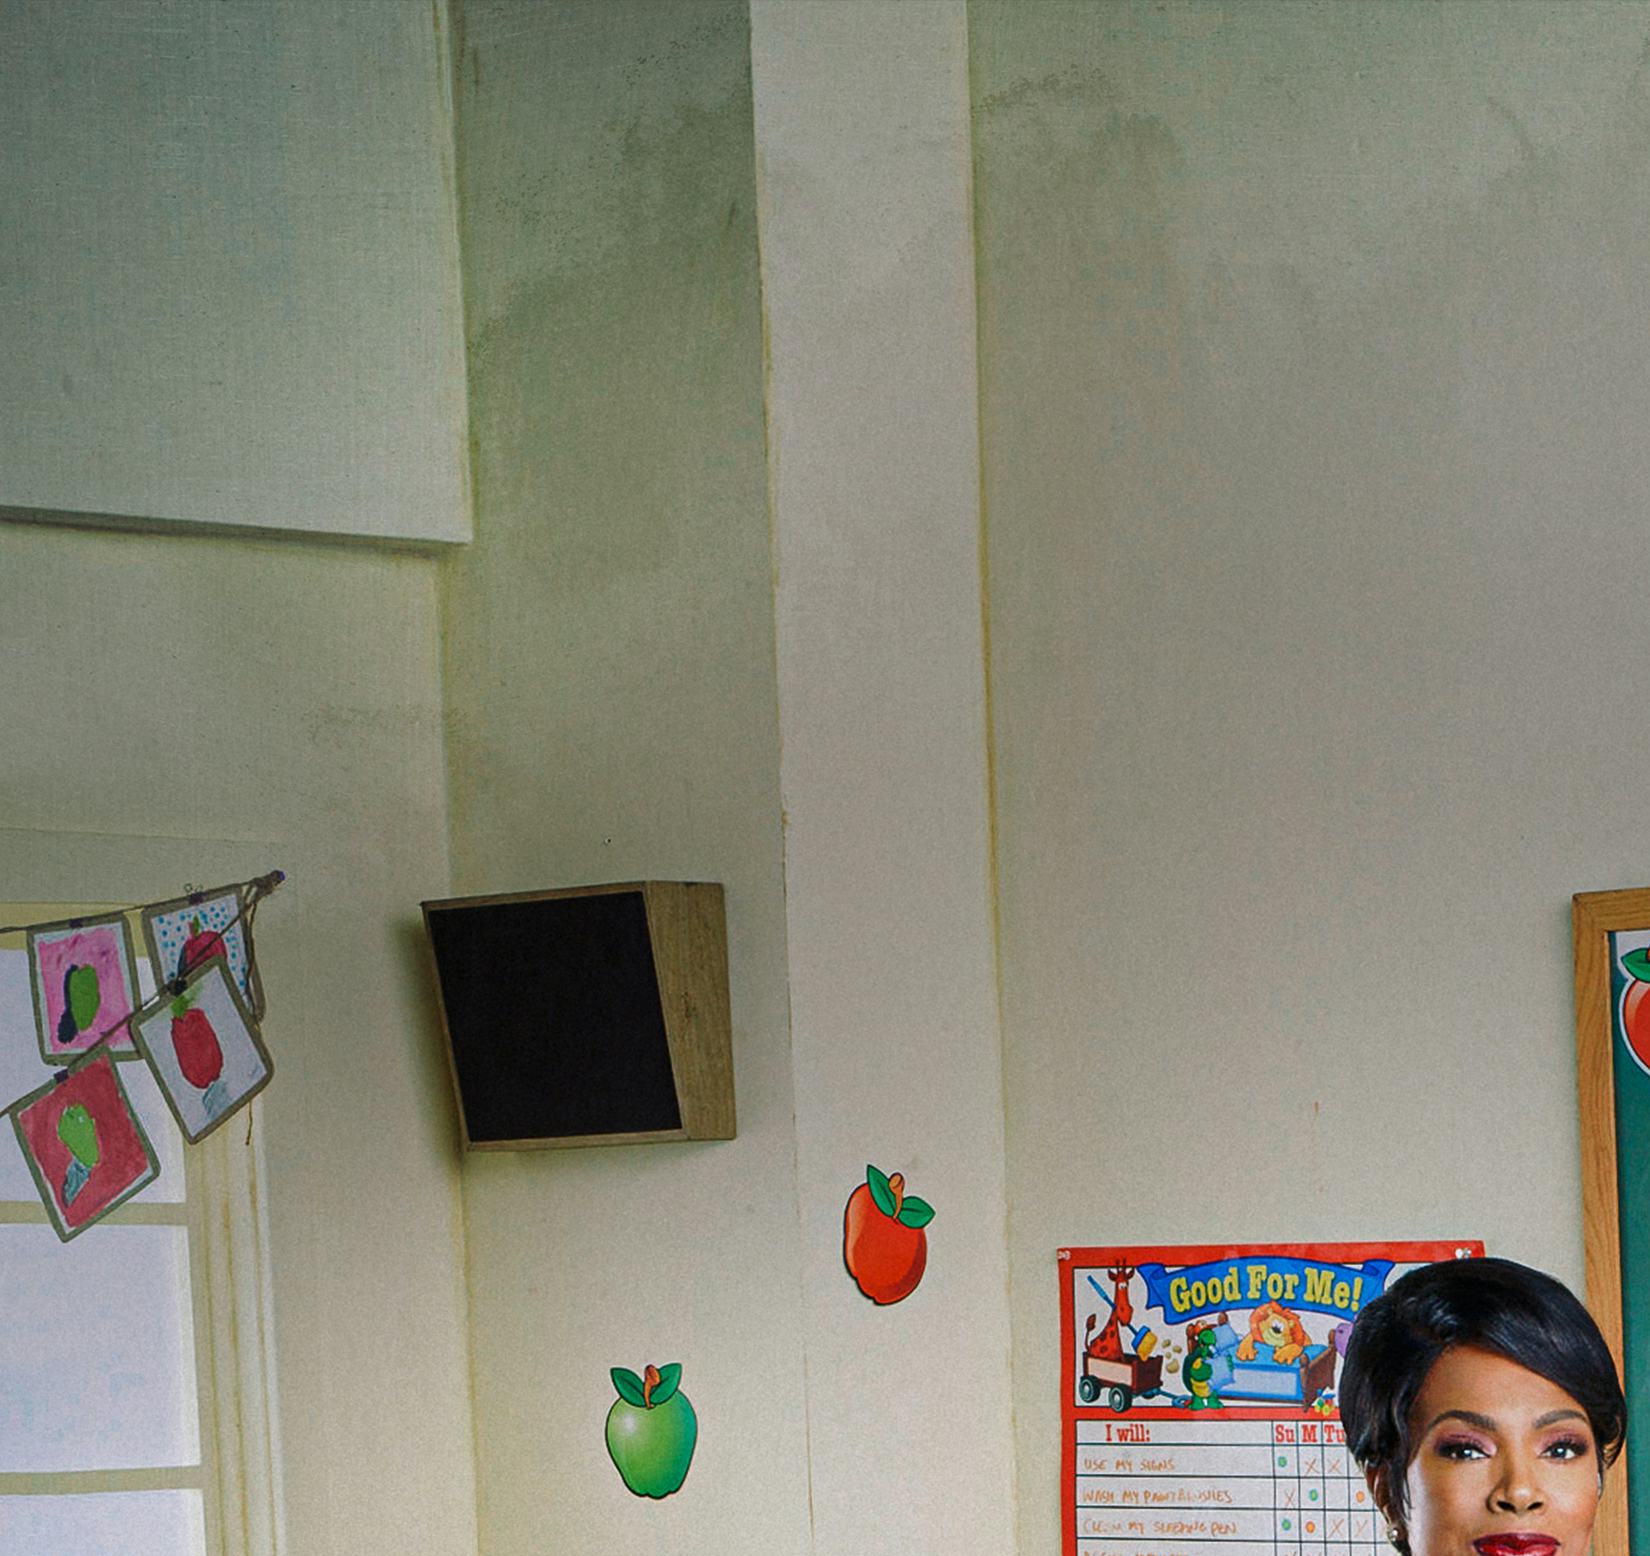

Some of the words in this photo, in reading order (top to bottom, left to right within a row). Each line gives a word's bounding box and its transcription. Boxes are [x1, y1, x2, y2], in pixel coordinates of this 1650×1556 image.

[1169, 1266, 1242, 1313] Good
[1247, 1264, 1299, 1301] For
[1303, 1266, 1363, 1313] Me!
[1105, 1424, 1112, 1442] I
[1116, 1424, 1151, 1443] will:
[1275, 1424, 1294, 1443] Su
[1301, 1424, 1318, 1443] M
[1323, 1424, 1345, 1443] Tu
[1083, 1458, 1107, 1470] USE
[1115, 1459, 1133, 1472] MY
[1140, 1458, 1175, 1472] SIGNS
[1082, 1489, 1114, 1504] WASH
[1122, 1489, 1139, 1504] MY
[1127, 1521, 1144, 1535] MY
[1210, 1521, 1237, 1537] PEN
